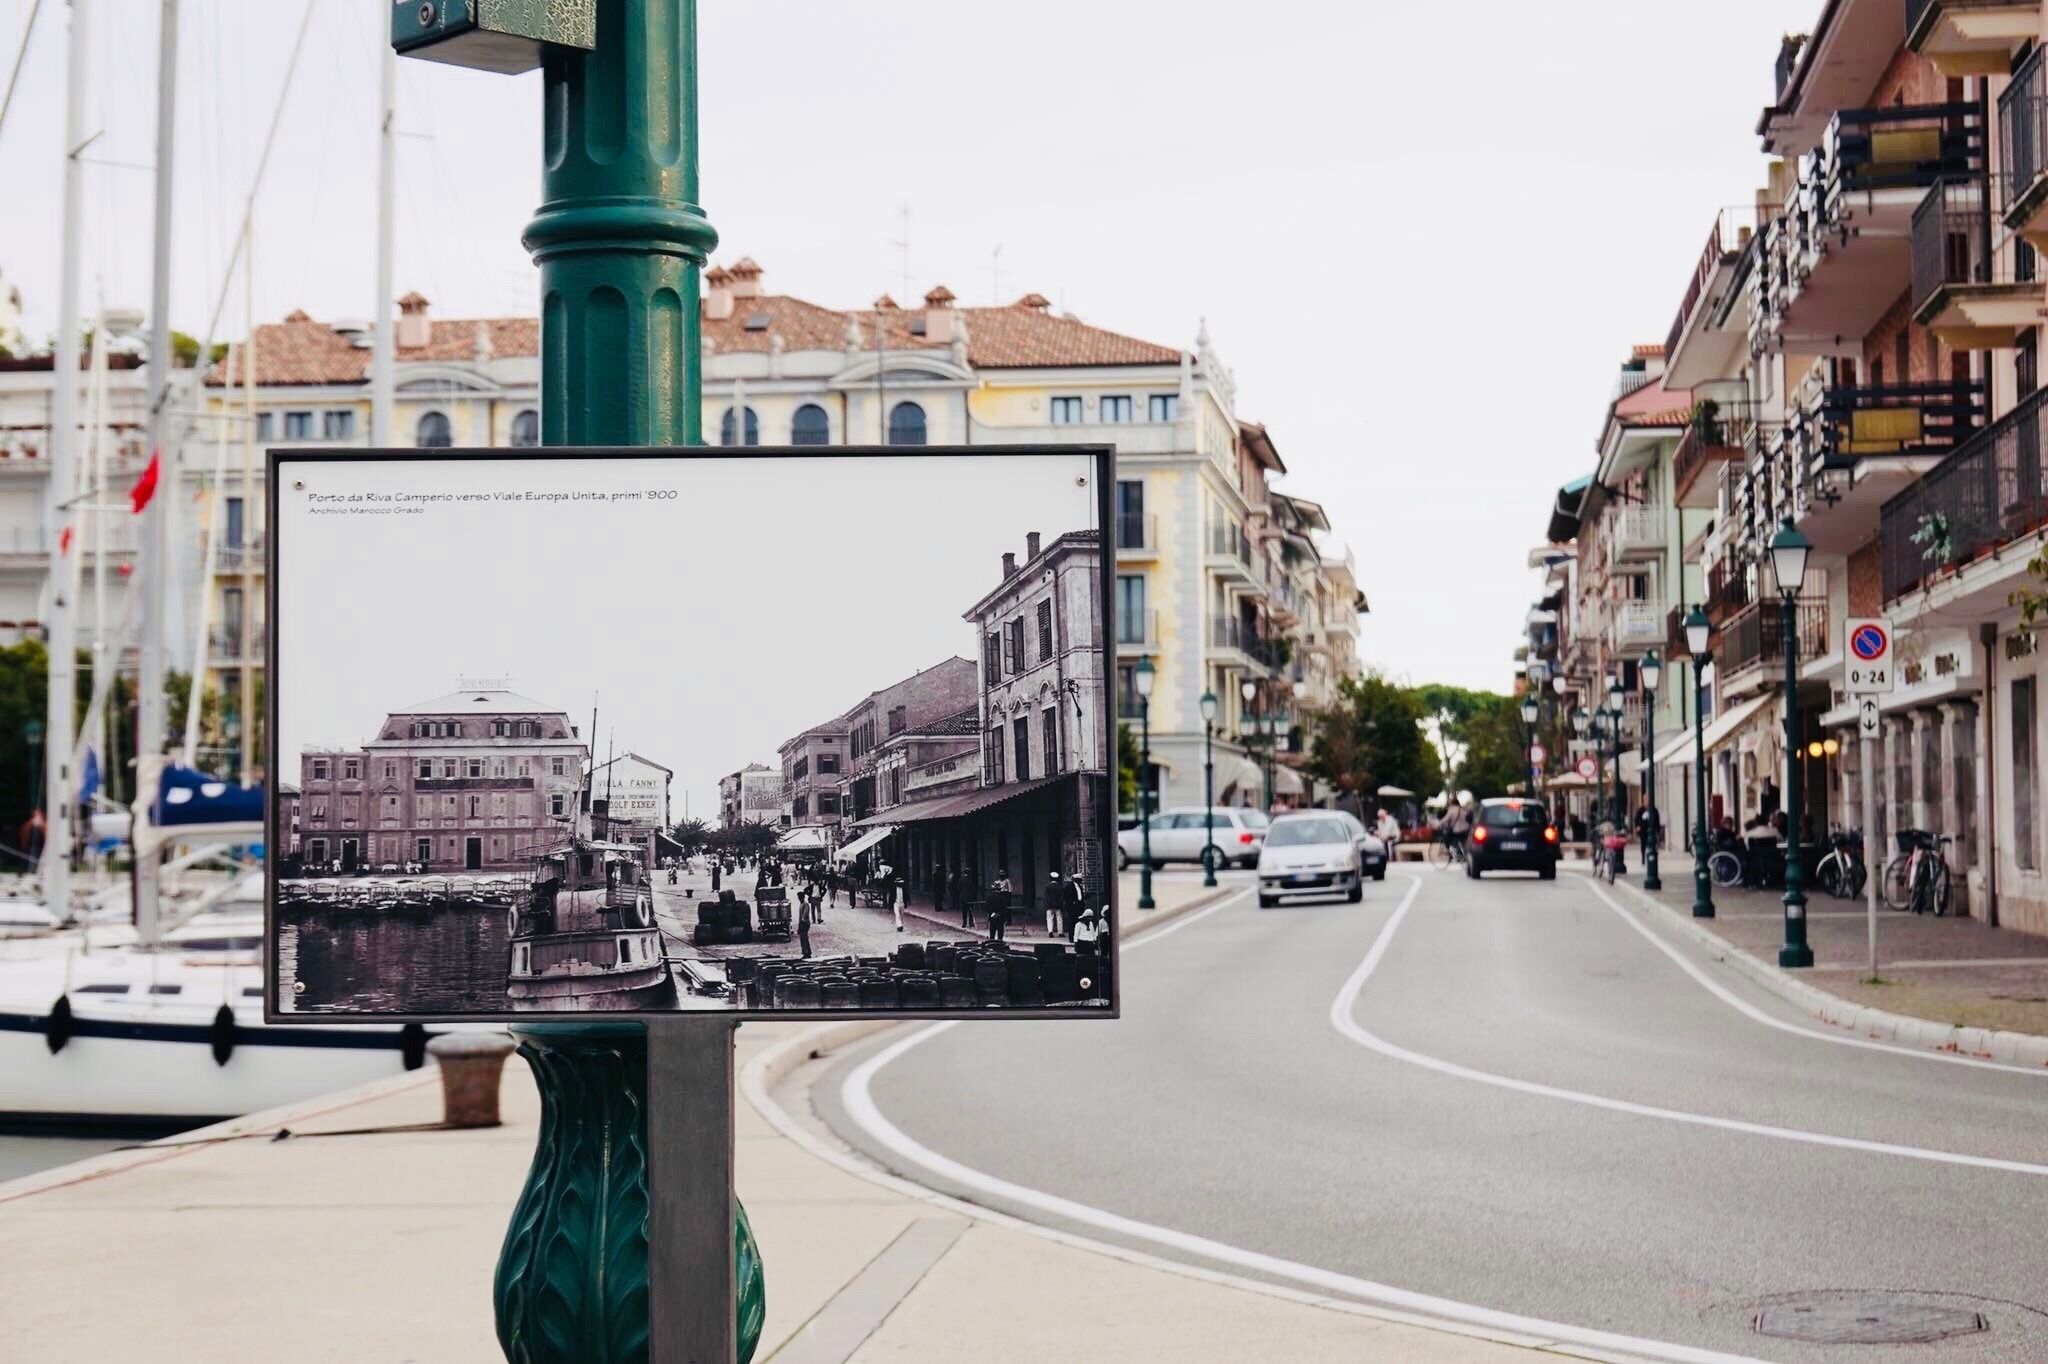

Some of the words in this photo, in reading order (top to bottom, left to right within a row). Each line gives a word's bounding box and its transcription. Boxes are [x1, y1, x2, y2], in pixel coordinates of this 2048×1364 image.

[308, 493, 345, 502] Porto
[348, 493, 363, 502] da
[366, 492, 392, 502] Riva
[394, 492, 453, 504] Camperio
[456, 493, 491, 501] verso
[493, 491, 523, 501] Viale
[525, 491, 569, 503] Europa
[571, 491, 609, 501] Unita,
[611, 490, 642, 503] primi
[309, 506, 348, 515] Archivio
[350, 506, 392, 514] Marocco
[394, 506, 425, 514] Grado
[597, 779, 623, 788] VILA
[630, 779, 657, 788] FANNY
[609, 800, 628, 809] DOLF
